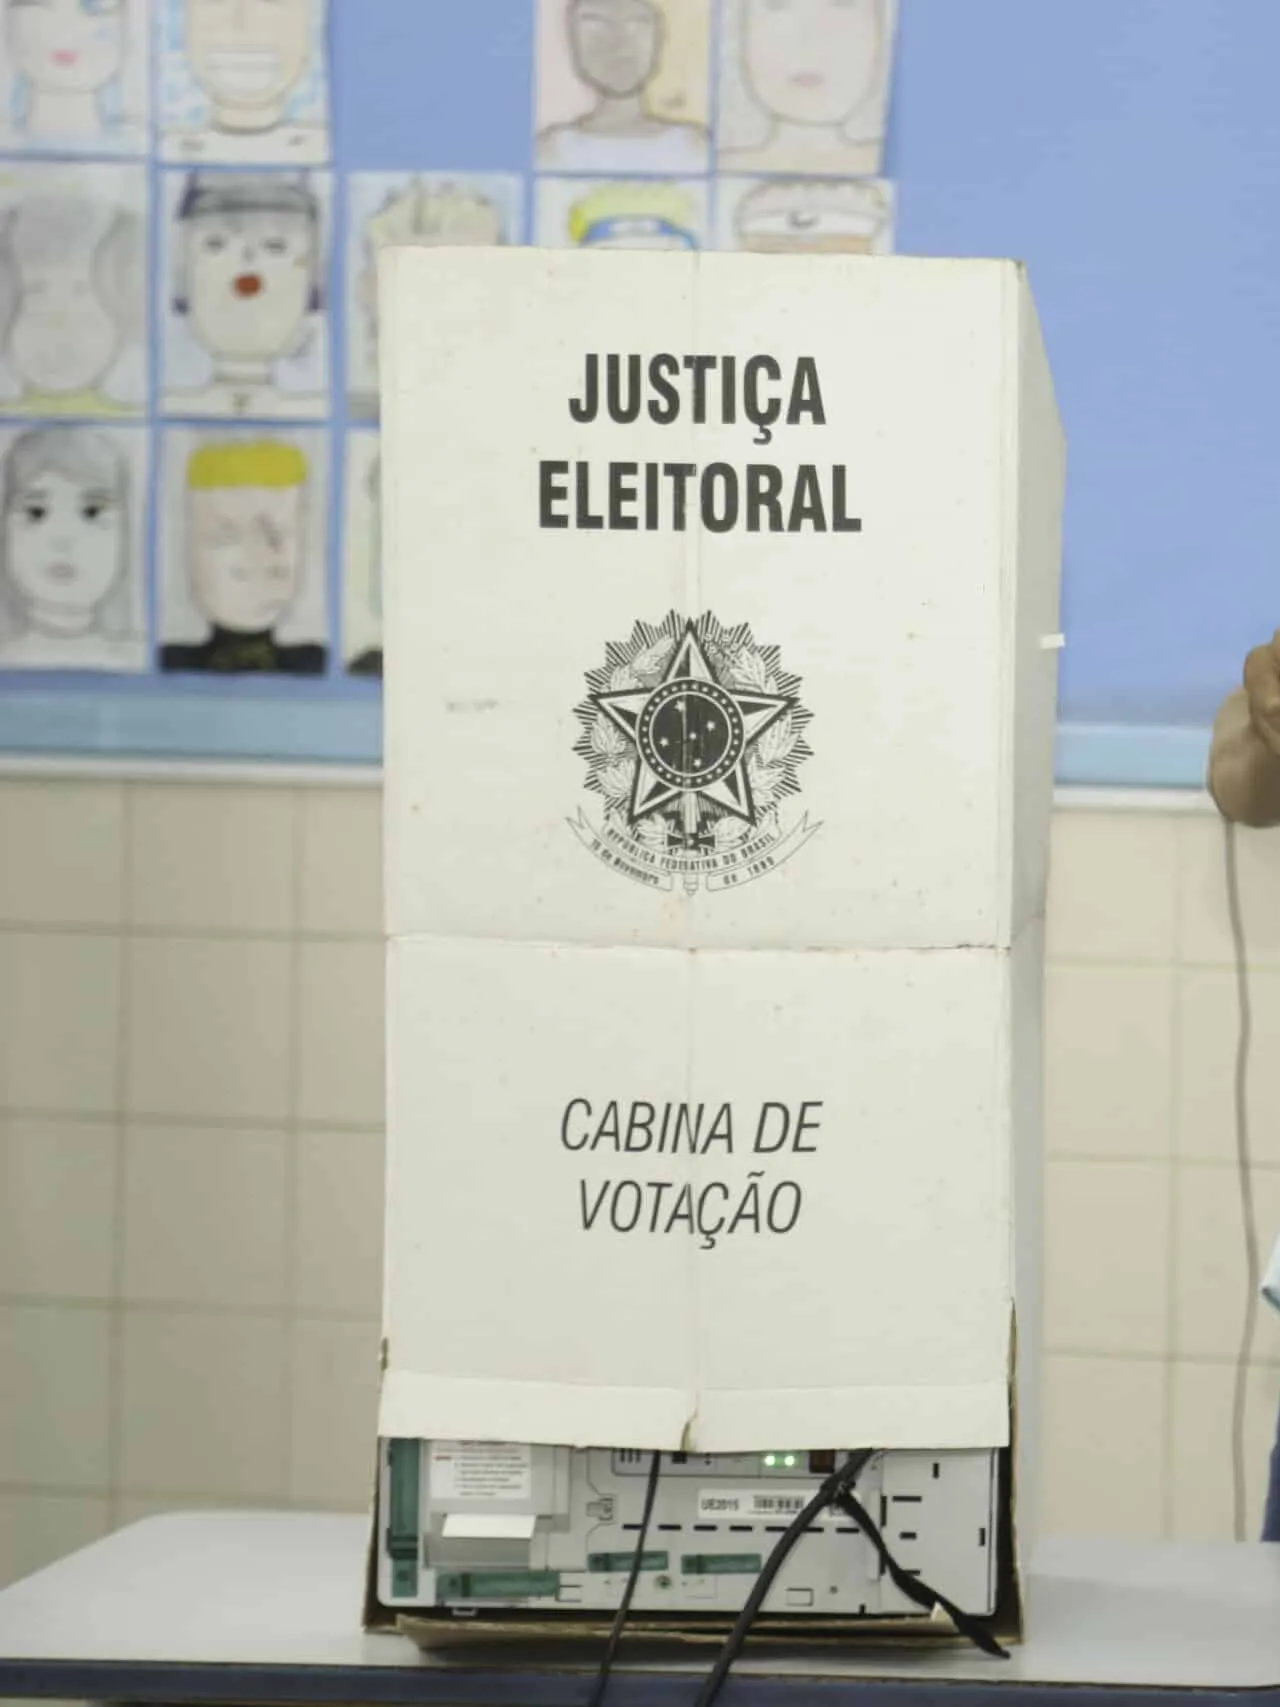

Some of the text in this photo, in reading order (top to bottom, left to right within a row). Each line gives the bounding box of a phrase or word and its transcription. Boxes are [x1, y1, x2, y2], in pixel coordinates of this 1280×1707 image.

[569, 353, 826, 445] JUSTIÇA
[539, 460, 862, 533] ELEITORAL
[721, 852, 738, 866] DO
[740, 832, 775, 859] BRASIL
[561, 1097, 823, 1156] CABINA DE
[580, 1170, 803, 1250] VOTAÇÃO
